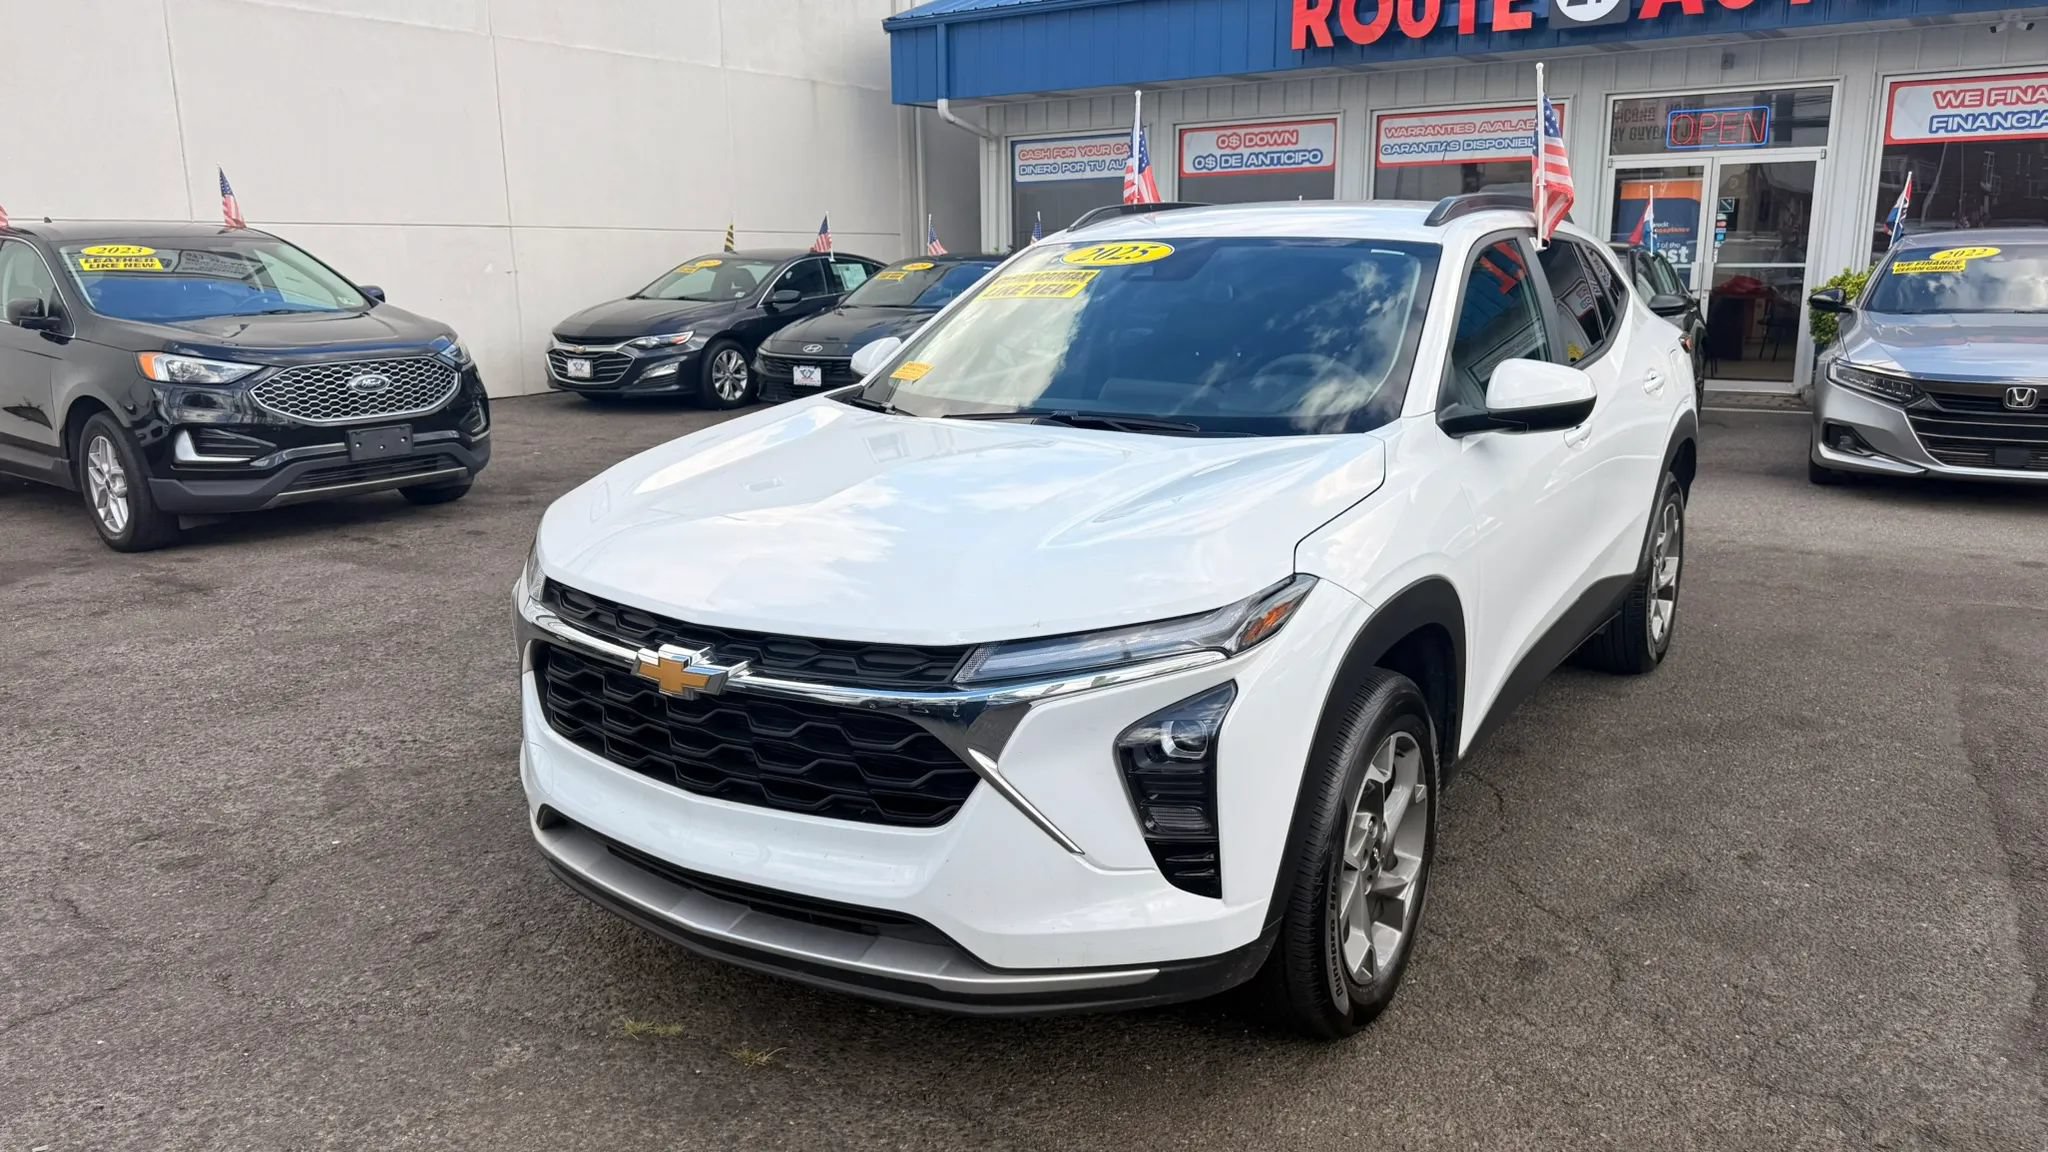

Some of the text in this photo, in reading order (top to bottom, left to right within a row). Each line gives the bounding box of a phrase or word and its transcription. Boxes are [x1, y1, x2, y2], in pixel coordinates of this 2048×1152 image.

[1933, 89, 1984, 109] WE
[1385, 118, 1536, 138] WARRANTIES AVAILAB
[1670, 111, 1767, 145] OPEN
[1243, 129, 1298, 148] DOWN
[1461, 136, 1533, 151] DISPONIBL
[1019, 143, 1130, 160] CASH FOR YOUR CA
[1219, 152, 1243, 169] DE
[1243, 149, 1323, 167] ANTICIPO
[1019, 162, 1060, 175] DINERO
[1061, 161, 1085, 173] POR
[1086, 159, 1106, 172] TU
[96, 247, 142, 255] 2023
[1074, 245, 1160, 262] 2025
[1943, 248, 1988, 259] 2022
[1023, 283, 1078, 295] NEW
